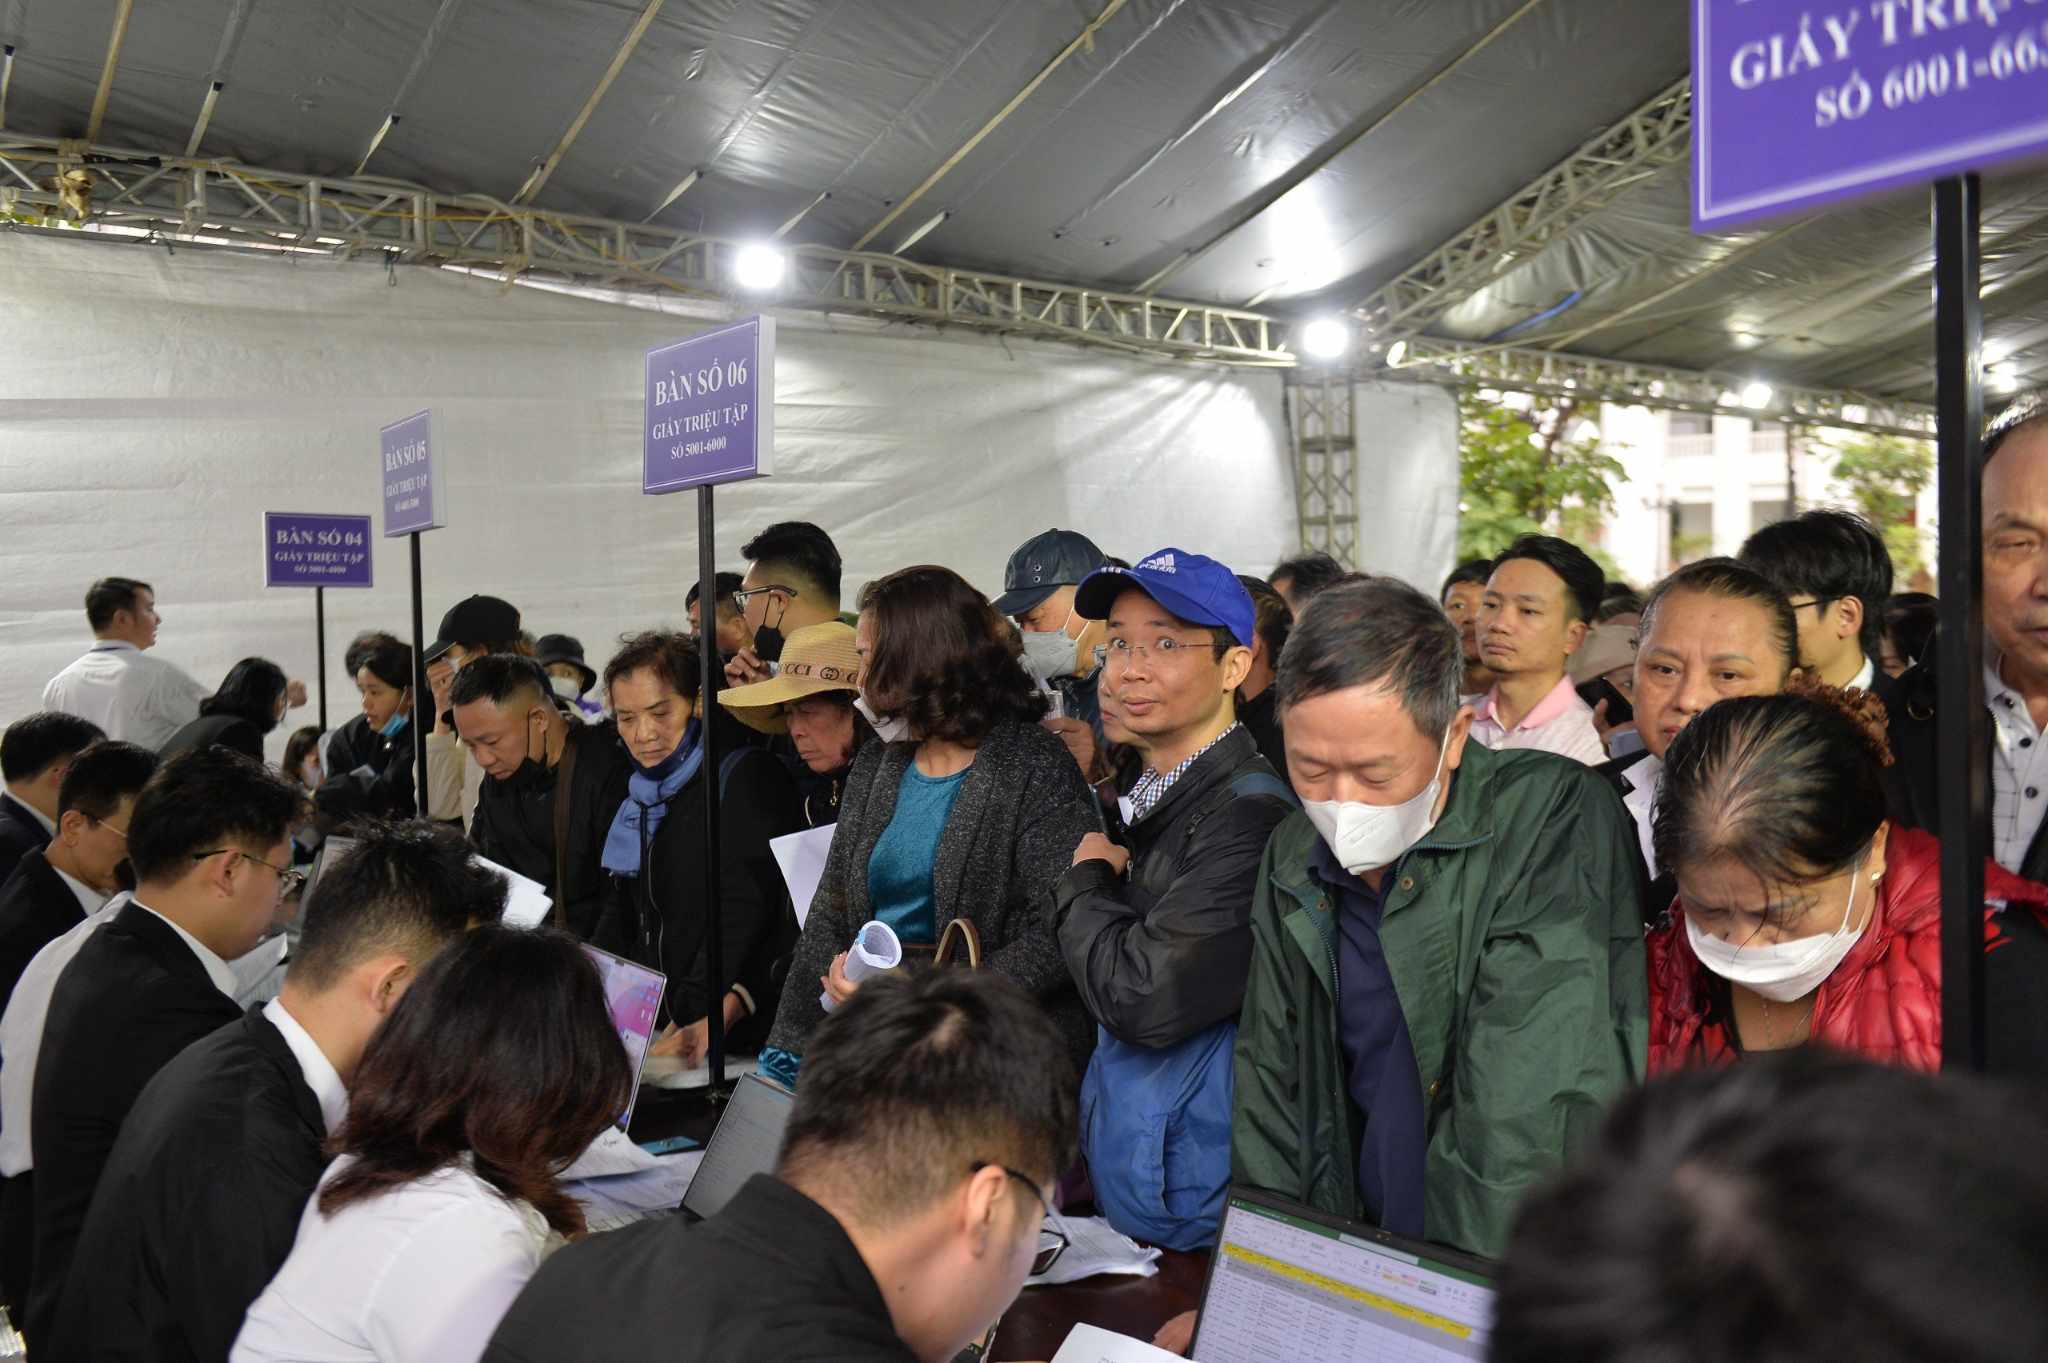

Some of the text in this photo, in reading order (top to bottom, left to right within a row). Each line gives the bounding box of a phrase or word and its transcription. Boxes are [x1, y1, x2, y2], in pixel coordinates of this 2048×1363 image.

[655, 357, 748, 407] BÀN SỐ 06
[683, 408, 721, 433] TRIỆU
[723, 401, 748, 427] TẬP
[685, 434, 727, 457] 5001-6000
[276, 526, 313, 545] BÀN
[344, 531, 363, 547] 04
